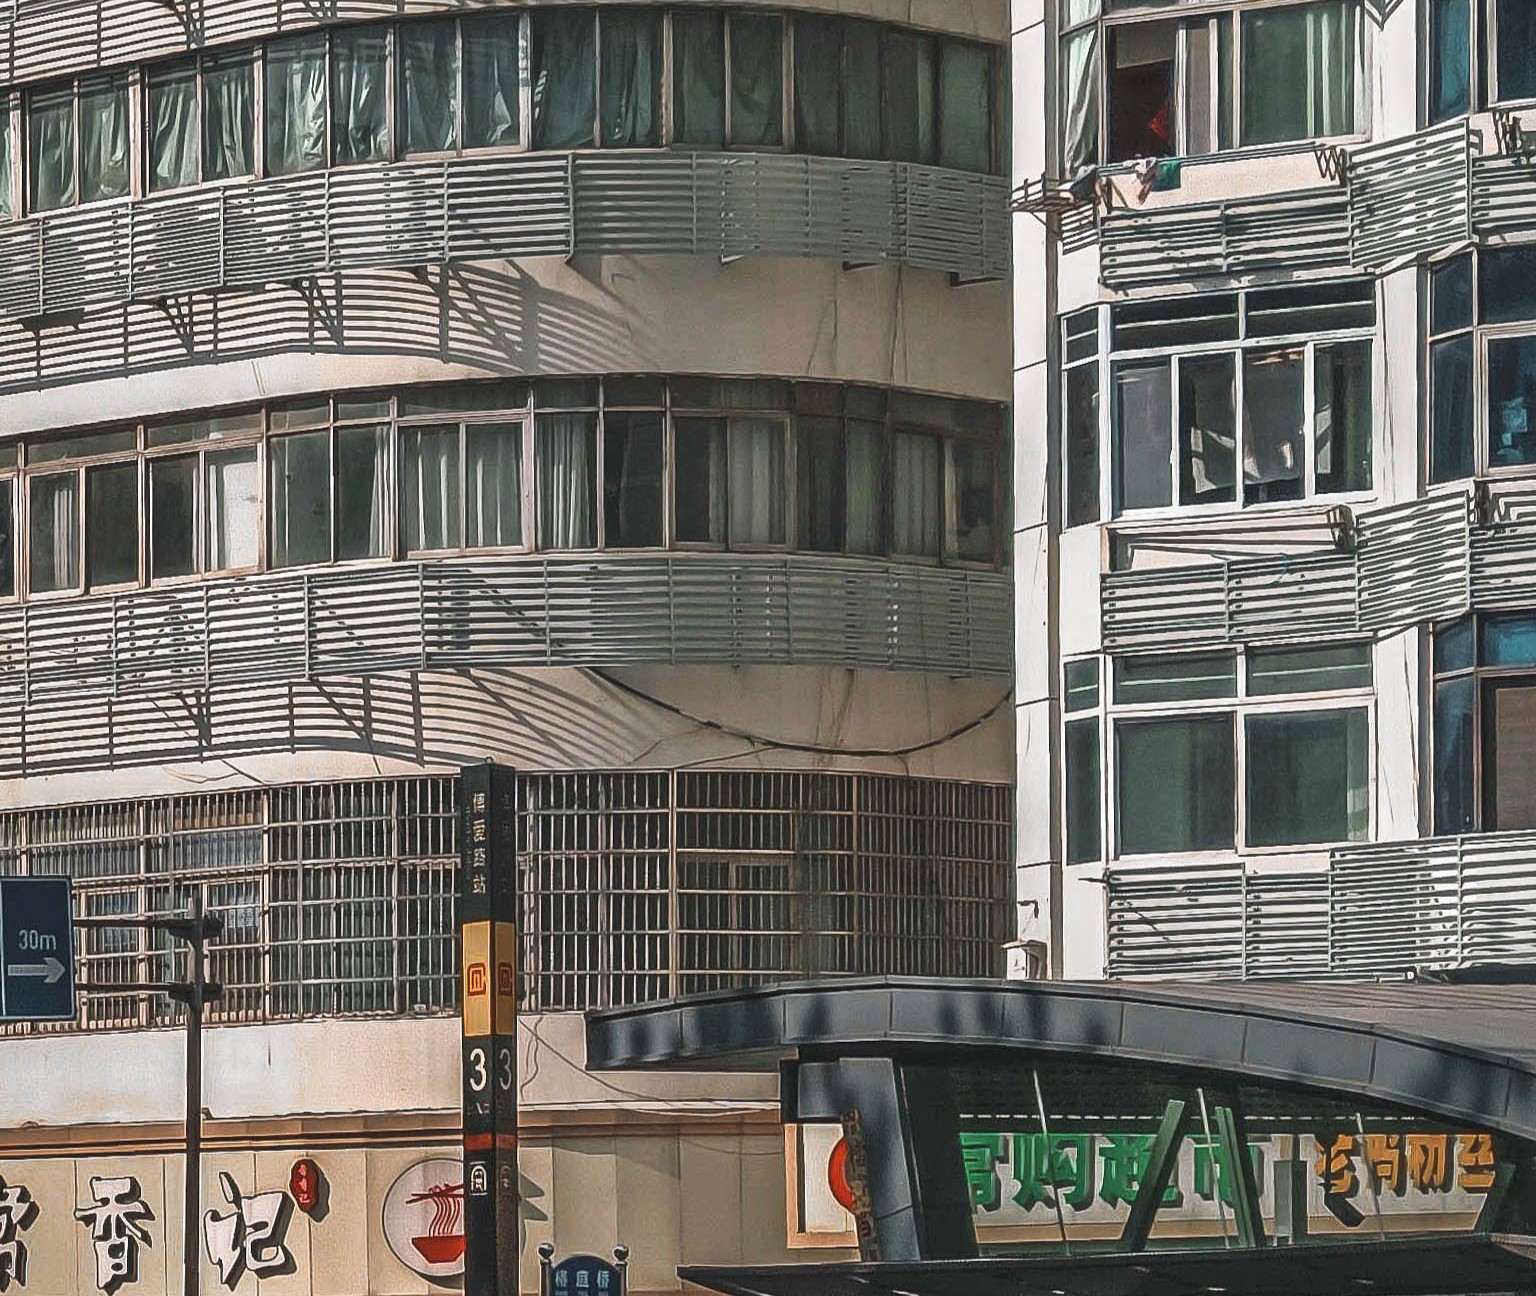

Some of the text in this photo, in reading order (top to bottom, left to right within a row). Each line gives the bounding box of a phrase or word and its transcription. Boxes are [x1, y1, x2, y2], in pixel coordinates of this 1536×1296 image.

[18, 930, 57, 951] 30m
[469, 1048, 488, 1092] 3
[499, 1048, 512, 1091] 3
